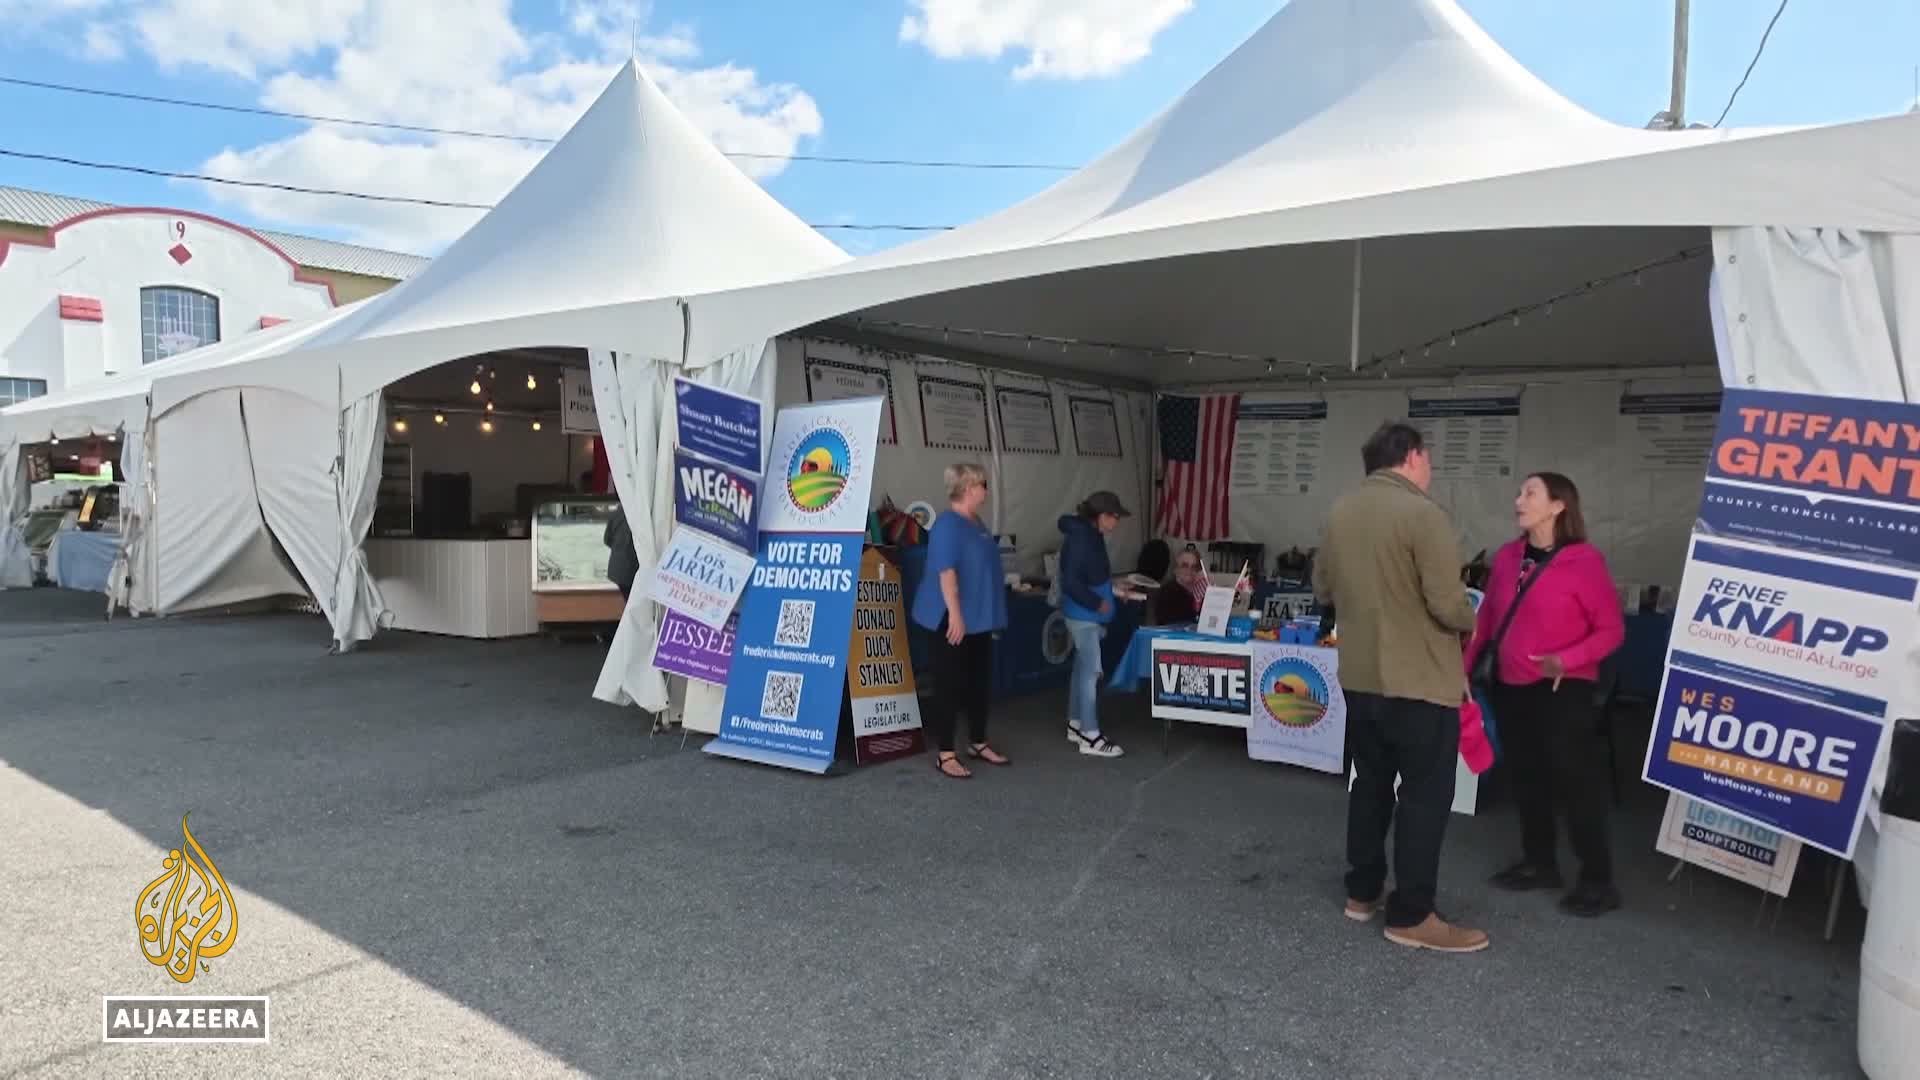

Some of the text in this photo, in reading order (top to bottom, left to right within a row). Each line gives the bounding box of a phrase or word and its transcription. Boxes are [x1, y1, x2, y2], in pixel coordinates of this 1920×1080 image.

[176, 221, 186, 239] 9
[715, 415, 757, 437] Butcher
[1739, 407, 1920, 452] TIFFANY
[1717, 438, 1920, 500] GRANT
[680, 466, 753, 525] MEGAN
[1707, 495, 1763, 509] COUNTY
[1771, 503, 1837, 521] COUNCIL
[767, 542, 843, 565] VOTE FOR
[663, 548, 738, 594] JARMAN
[752, 565, 852, 593] DEMOCRATS
[1708, 577, 1788, 607] RENEE
[856, 608, 896, 630] DONALD
[1693, 593, 1889, 657] KNAPP
[865, 635, 893, 658] DUCK
[1688, 623, 1751, 648] County
[1744, 636, 1803, 660] Council
[1806, 650, 1880, 679] At-Large
[858, 662, 904, 686] STANLEY
[874, 701, 897, 714] STATE
[1682, 688, 1736, 711] WES
[864, 712, 910, 729] LEGISLATURE
[1672, 706, 1857, 778] MOORE
[1703, 754, 1829, 796] MARYLAND
[1703, 772, 1792, 804] WesMoore.com
[1686, 826, 1771, 862] COMPTROLLER
